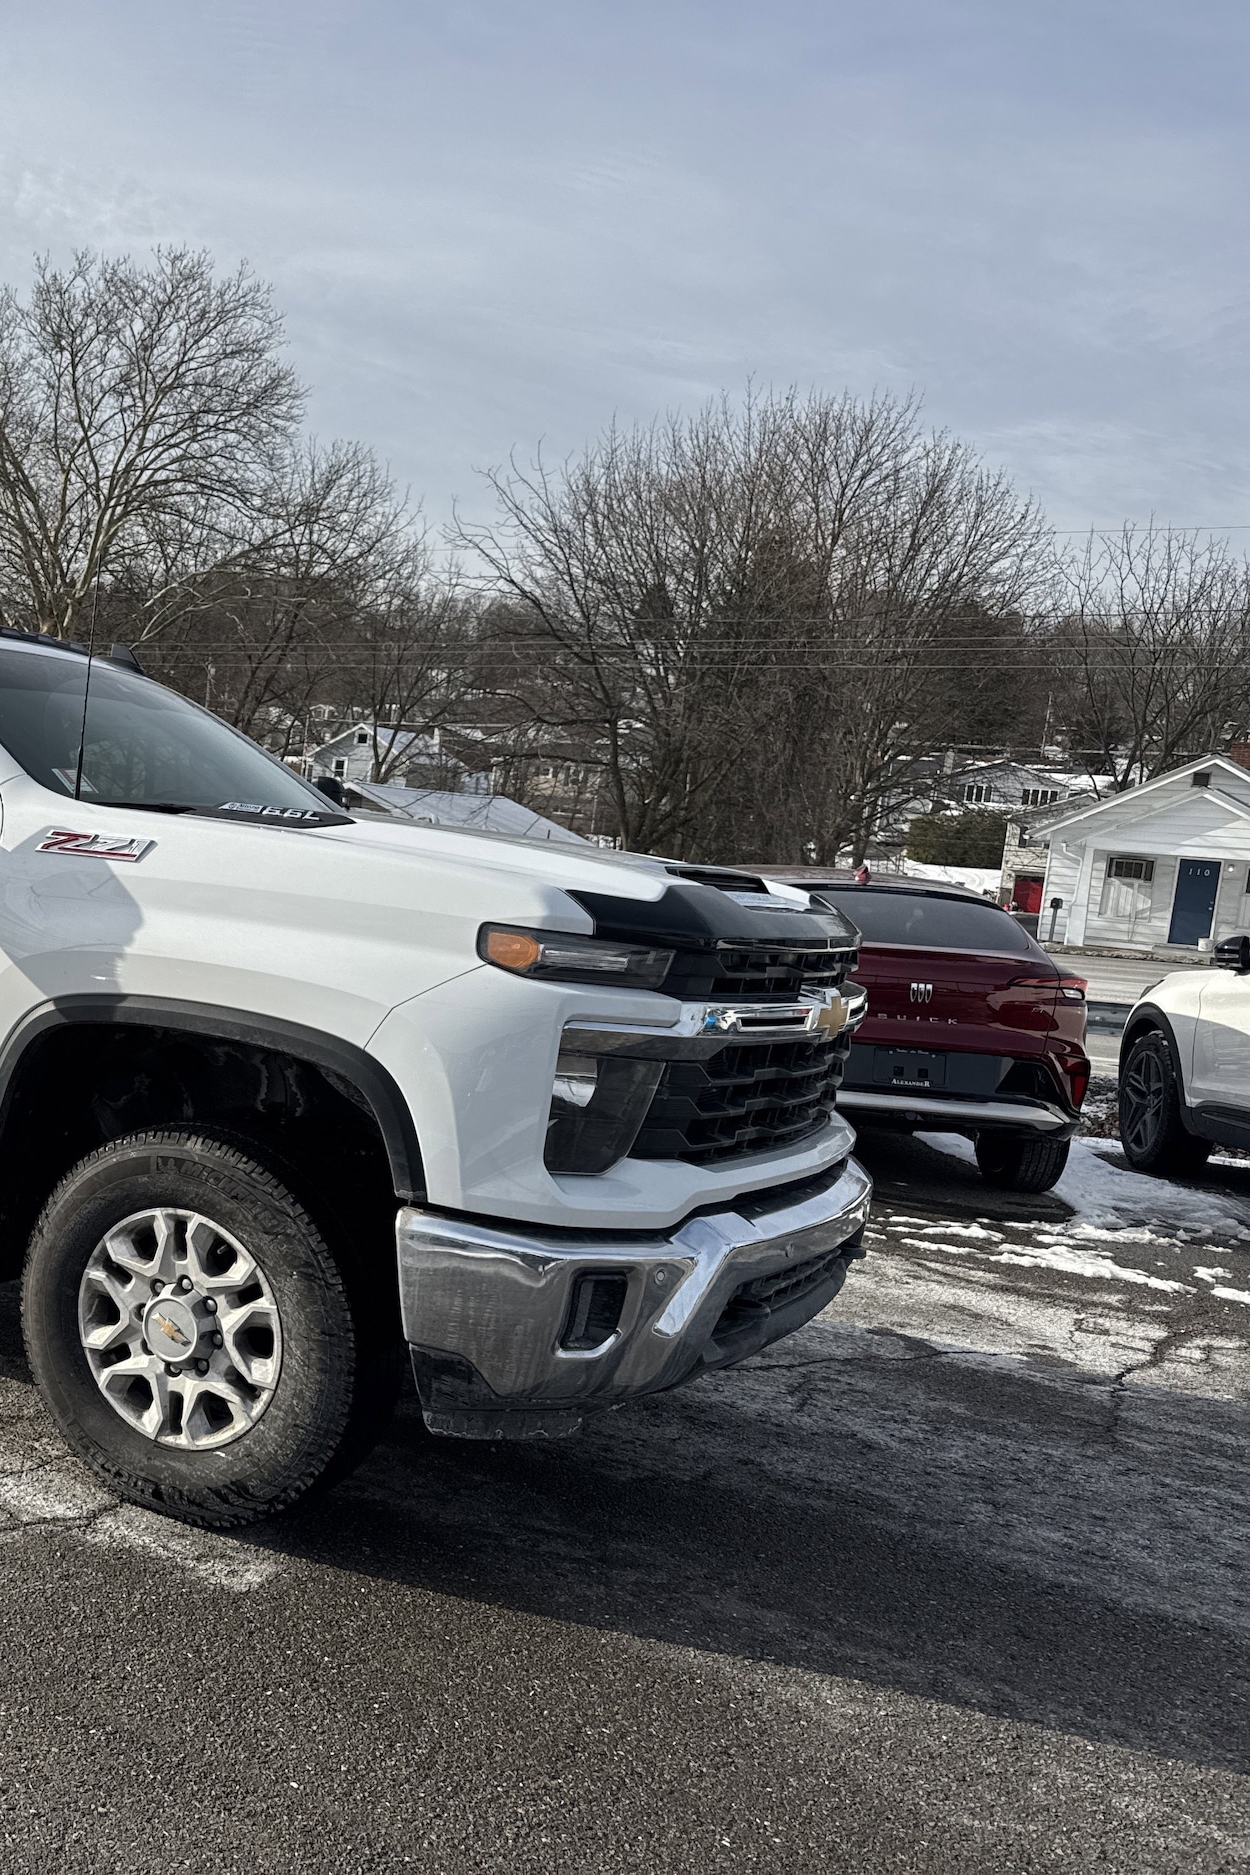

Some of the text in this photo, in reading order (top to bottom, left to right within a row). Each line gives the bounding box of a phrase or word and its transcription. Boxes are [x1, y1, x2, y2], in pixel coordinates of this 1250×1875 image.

[34, 829, 153, 863] Z71
[1188, 867, 1211, 877] 110
[877, 1012, 958, 1025] BUICK
